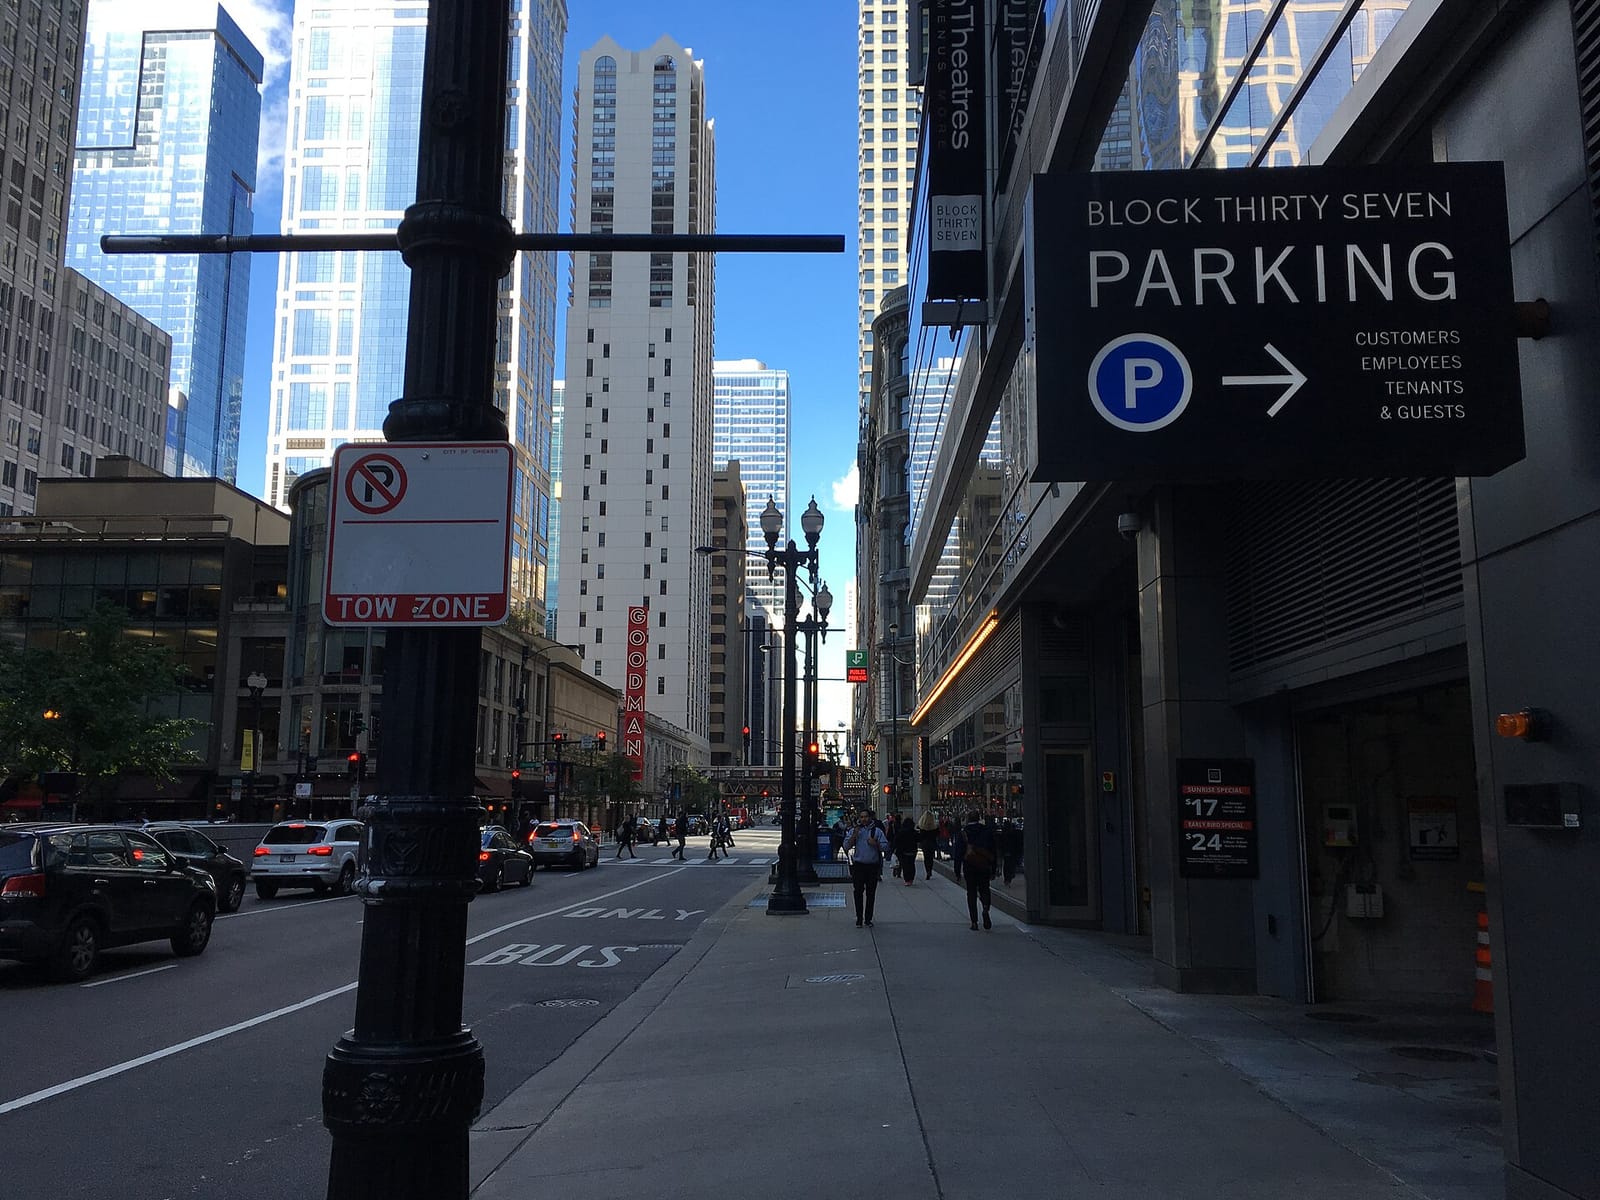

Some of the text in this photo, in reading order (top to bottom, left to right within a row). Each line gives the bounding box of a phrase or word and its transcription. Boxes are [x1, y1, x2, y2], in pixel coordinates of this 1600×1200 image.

[936, 204, 977, 216] BLOCK
[1088, 191, 1452, 226] BLOCK THIRTY SEVEN
[936, 217, 978, 228] THIRTY
[936, 230, 977, 241] SEVEN
[1089, 242, 1457, 308] PARKING
[1355, 330, 1461, 346] CUSTOMERS
[1361, 354, 1463, 371] EMPLOYEES
[1123, 357, 1164, 409] P
[1385, 379, 1464, 396] TENANTS
[1379, 404, 1466, 420] & GUESTS
[337, 596, 490, 619] TOW ZONE
[626, 607, 647, 757] GOODMAN
[1184, 798, 1218, 816] $17
[1185, 832, 1223, 851] $24
[562, 907, 705, 921] ONLY
[466, 943, 640, 968] BUS
